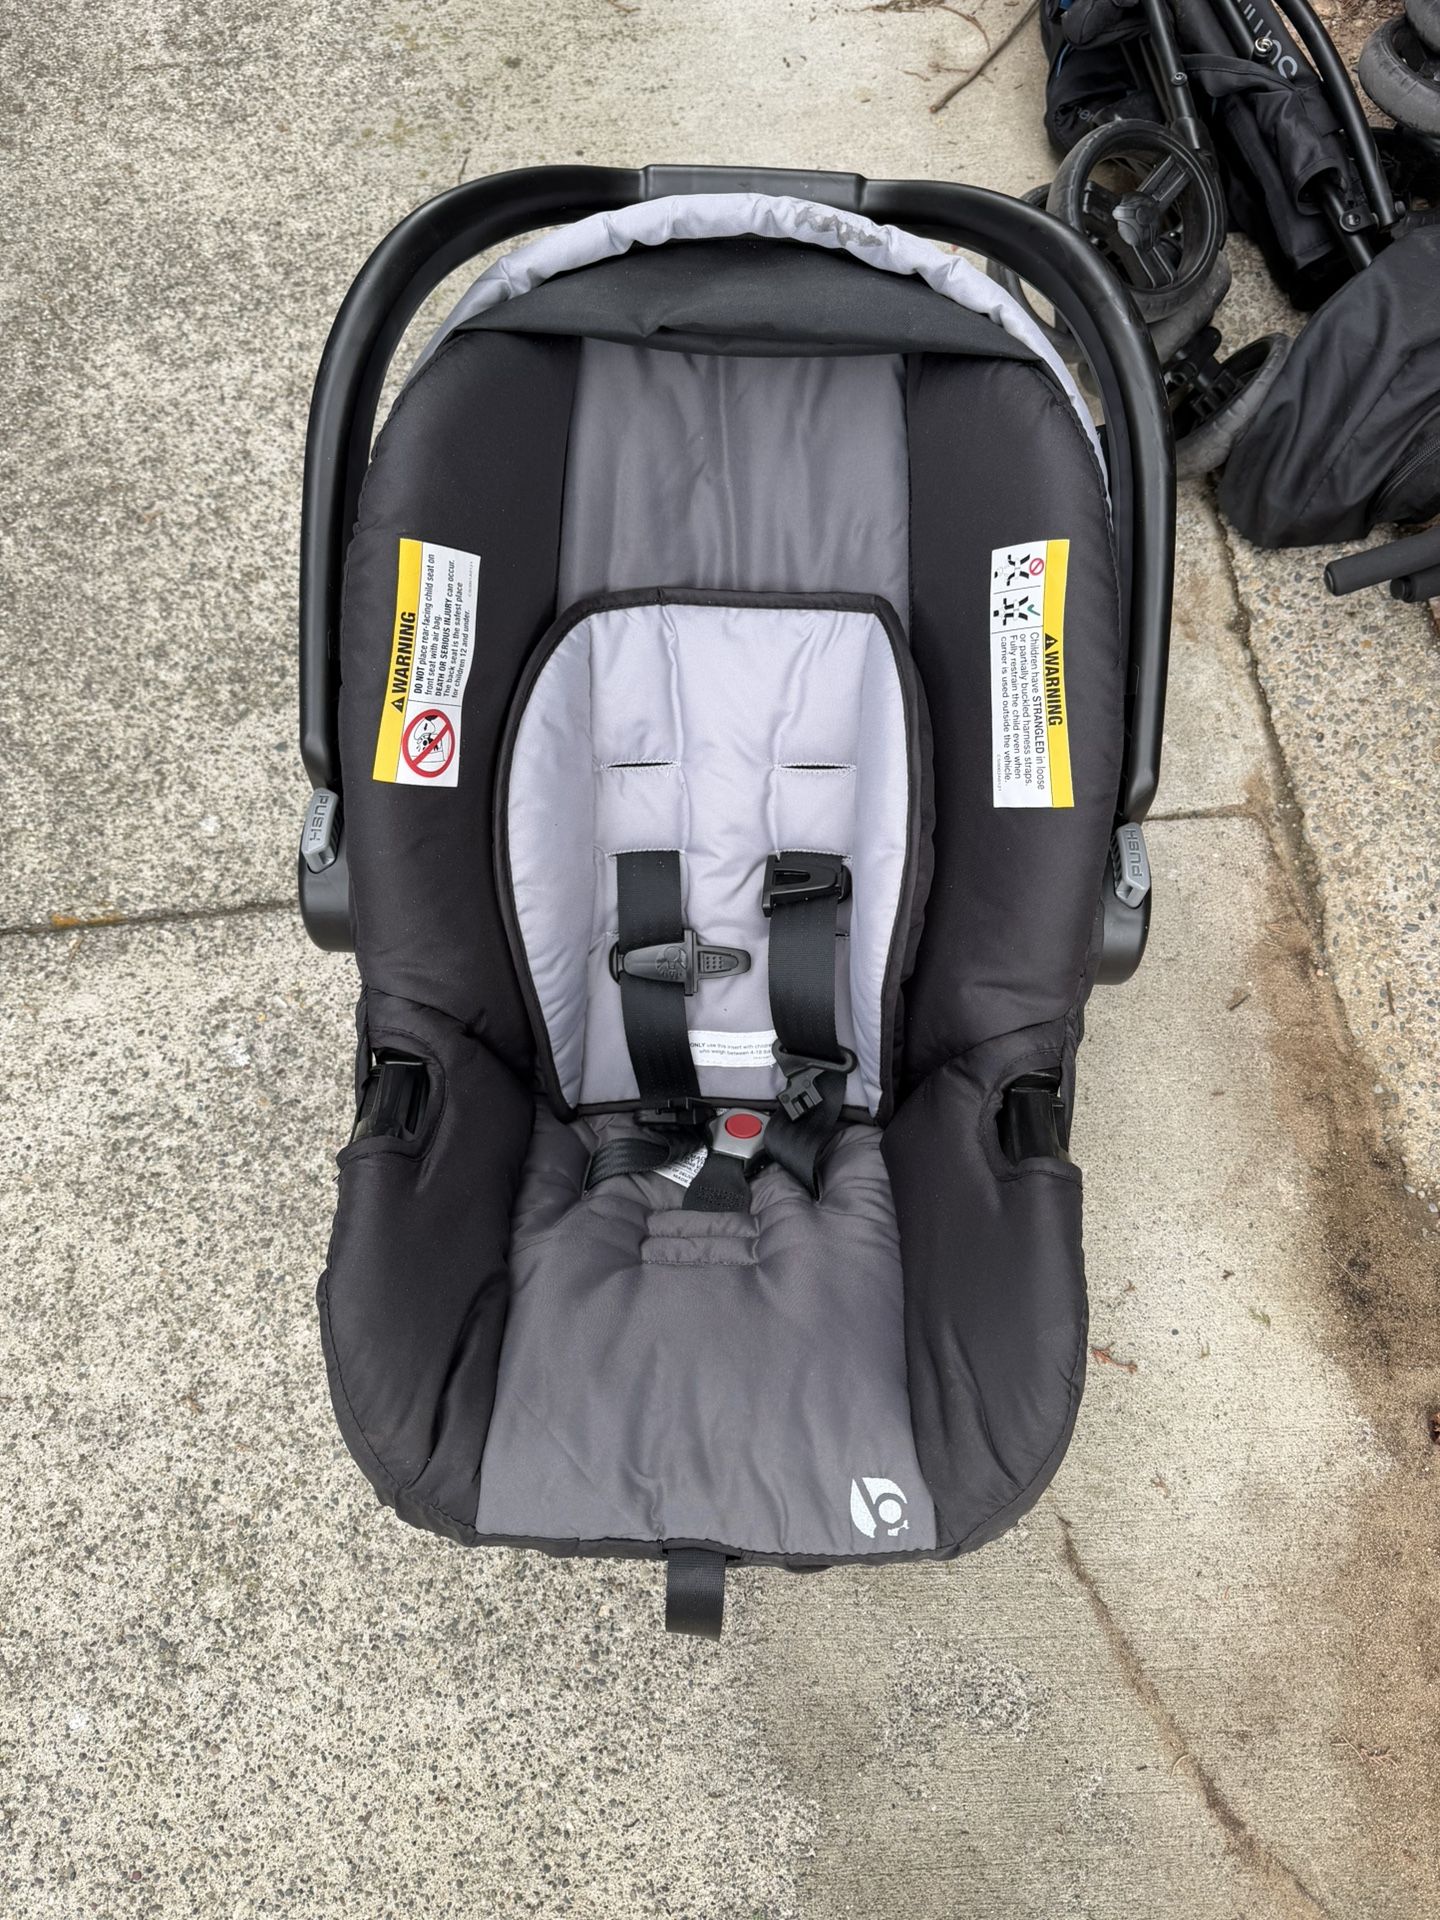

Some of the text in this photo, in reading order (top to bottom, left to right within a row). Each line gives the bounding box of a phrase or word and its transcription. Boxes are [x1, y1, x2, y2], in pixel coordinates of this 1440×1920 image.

[428, 554, 435, 564] on
[424, 583, 433, 601] child
[421, 603, 433, 643] rear-facing
[432, 615, 442, 630] bag.
[444, 598, 452, 625] INJURY
[440, 628, 450, 659] SERIOUS
[447, 666, 455, 683] back
[455, 582, 463, 602] place
[1008, 635, 1018, 655] Fully
[392, 612, 415, 693] WARNING
[418, 645, 427, 665] place
[430, 643, 438, 659] with
[416, 666, 424, 681] NOT
[428, 661, 436, 676] seat
[439, 662, 446, 671] OR
[454, 659, 465, 687] children
[460, 648, 467, 657] 12
[1010, 658, 1018, 691] restrain
[414, 683, 422, 694] DO
[425, 678, 434, 695] front
[435, 673, 444, 696] DEATH
[1045, 650, 1063, 726] WARNING
[1002, 700, 1011, 732] outside
[1012, 710, 1020, 730] child
[1019, 634, 1032, 786] or partially buckled harness straps.
[1030, 632, 1046, 790] Children have STRANGLED in loose
[1004, 751, 1012, 782] vehicle.
[309, 795, 329, 841] PUSH
[1125, 828, 1143, 877] PUSH
